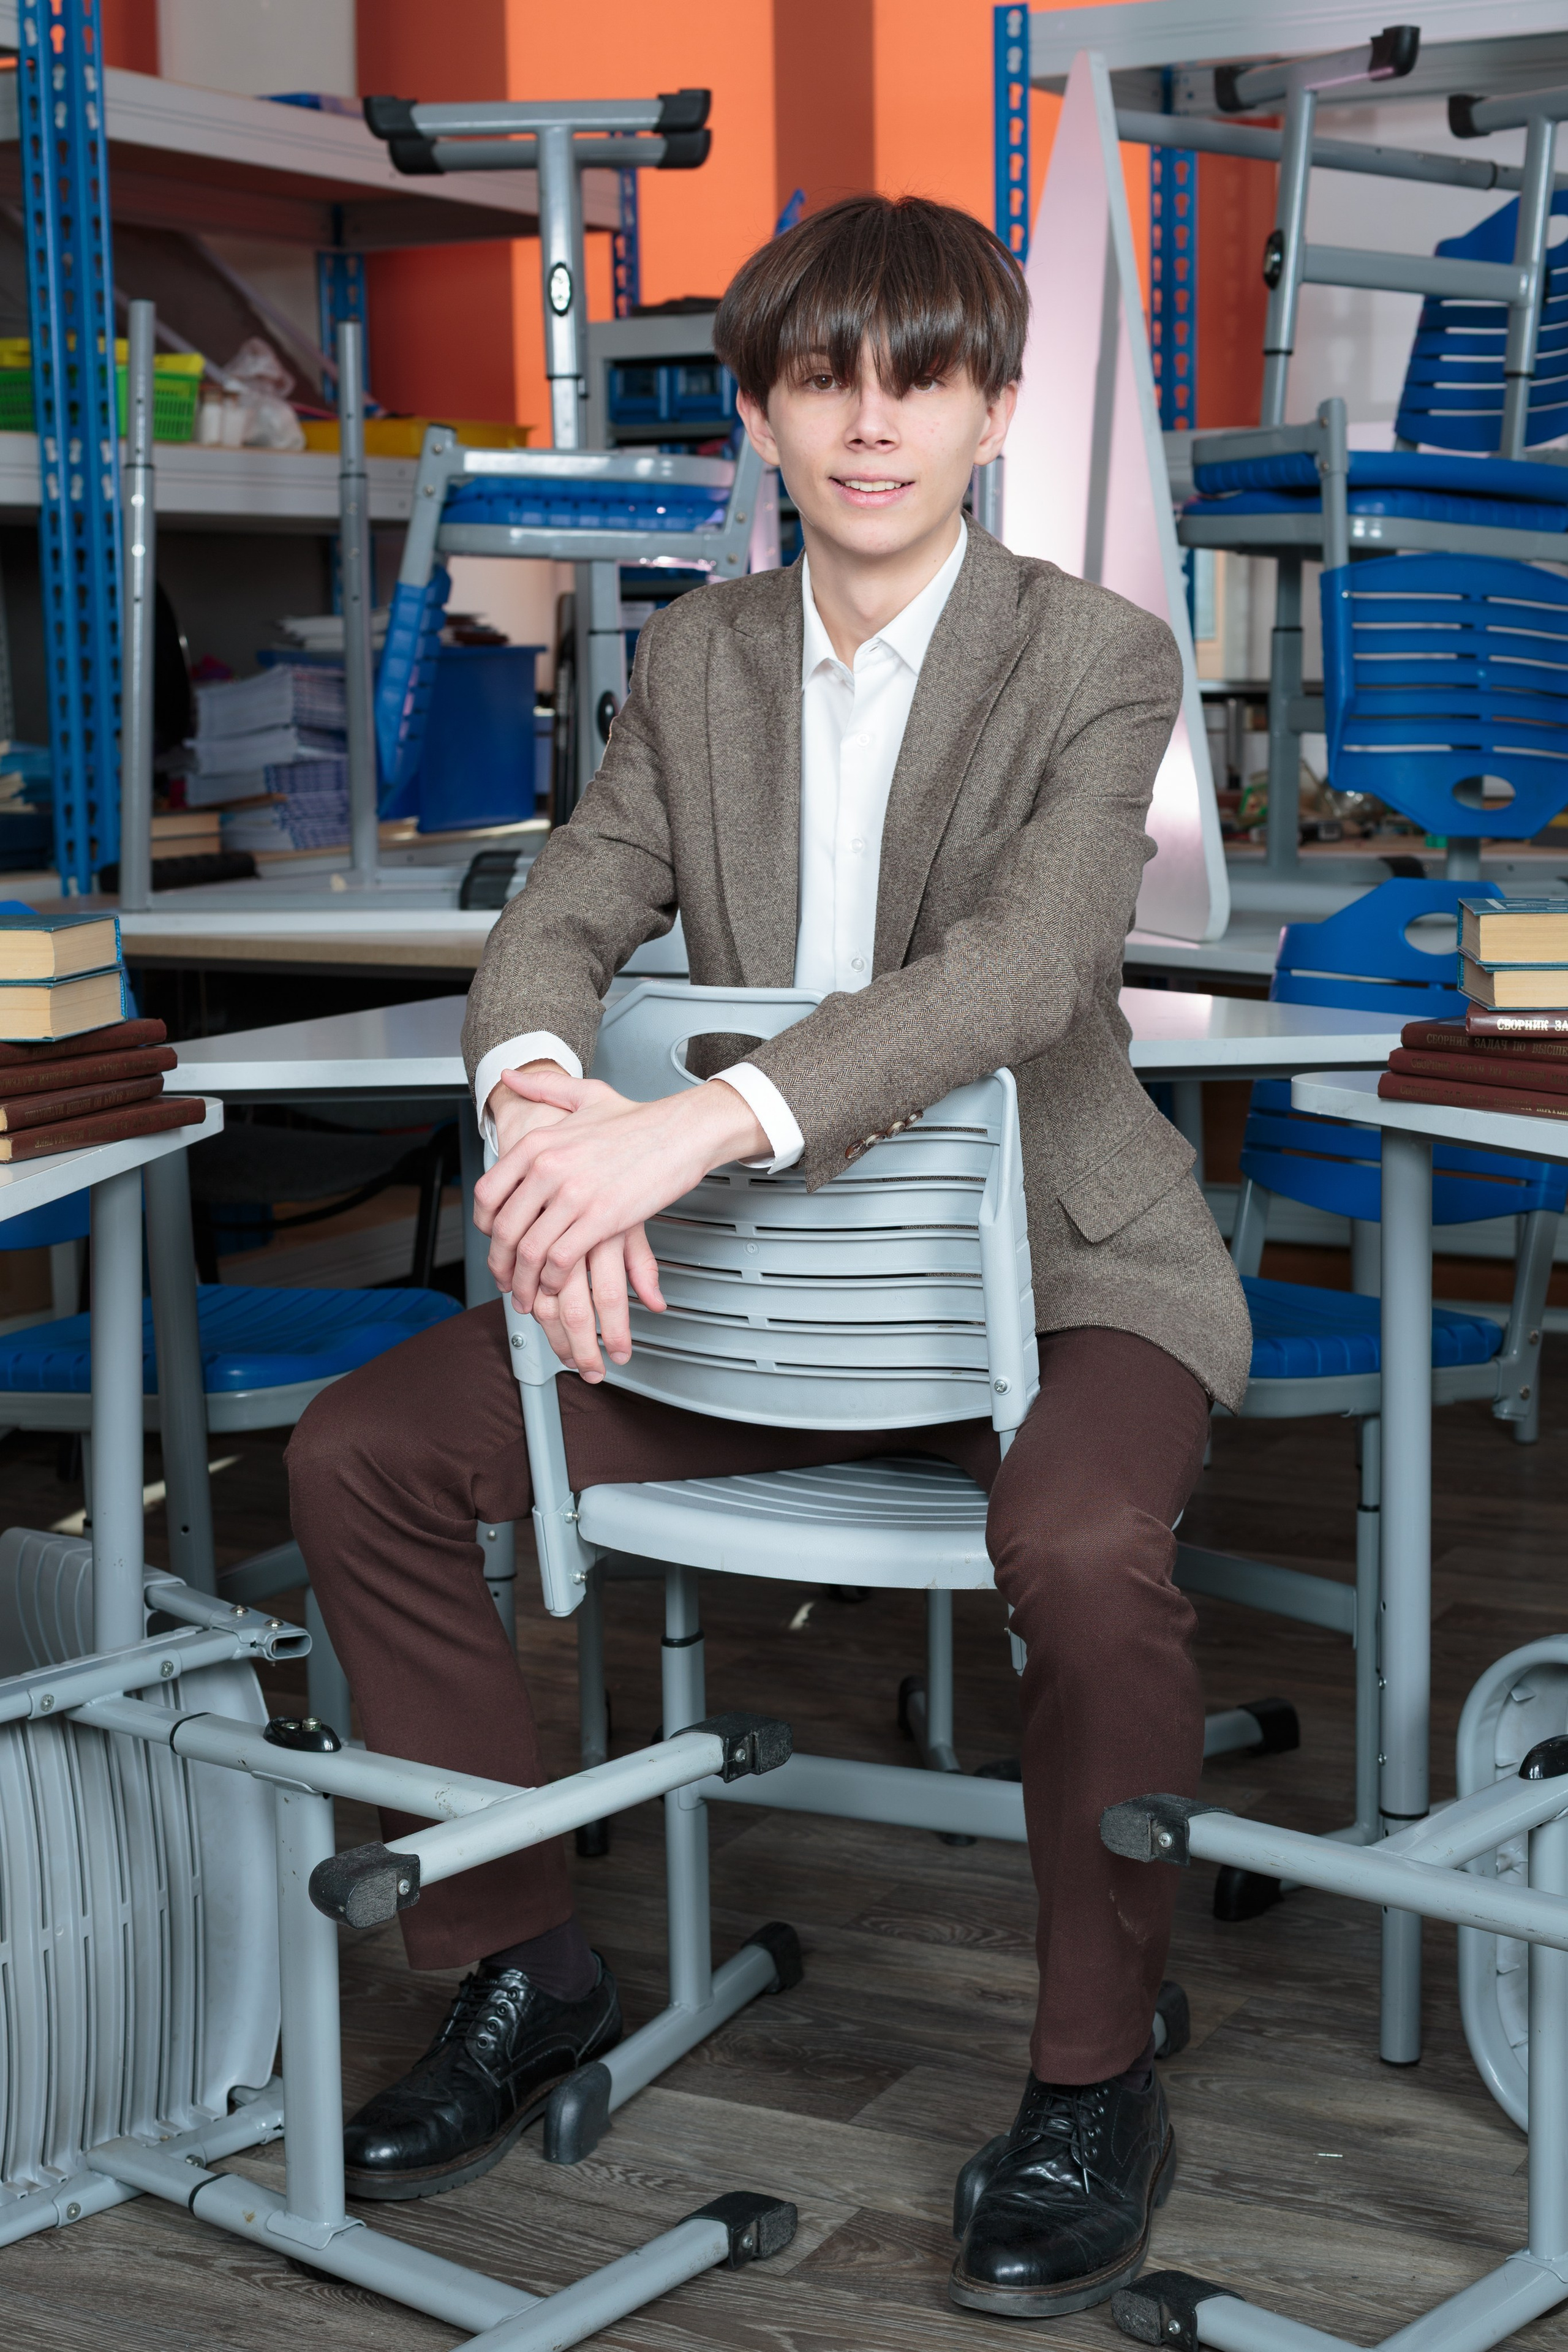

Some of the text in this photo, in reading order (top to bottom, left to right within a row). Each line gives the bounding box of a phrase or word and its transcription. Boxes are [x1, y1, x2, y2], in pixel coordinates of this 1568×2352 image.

[1496, 1019, 1549, 1031] СБОРНИК
[1427, 1033, 1470, 1047] СБОРНИК
[1474, 1038, 1508, 1051] ЗАДАЧ
[1512, 1041, 1526, 1052] ПО
